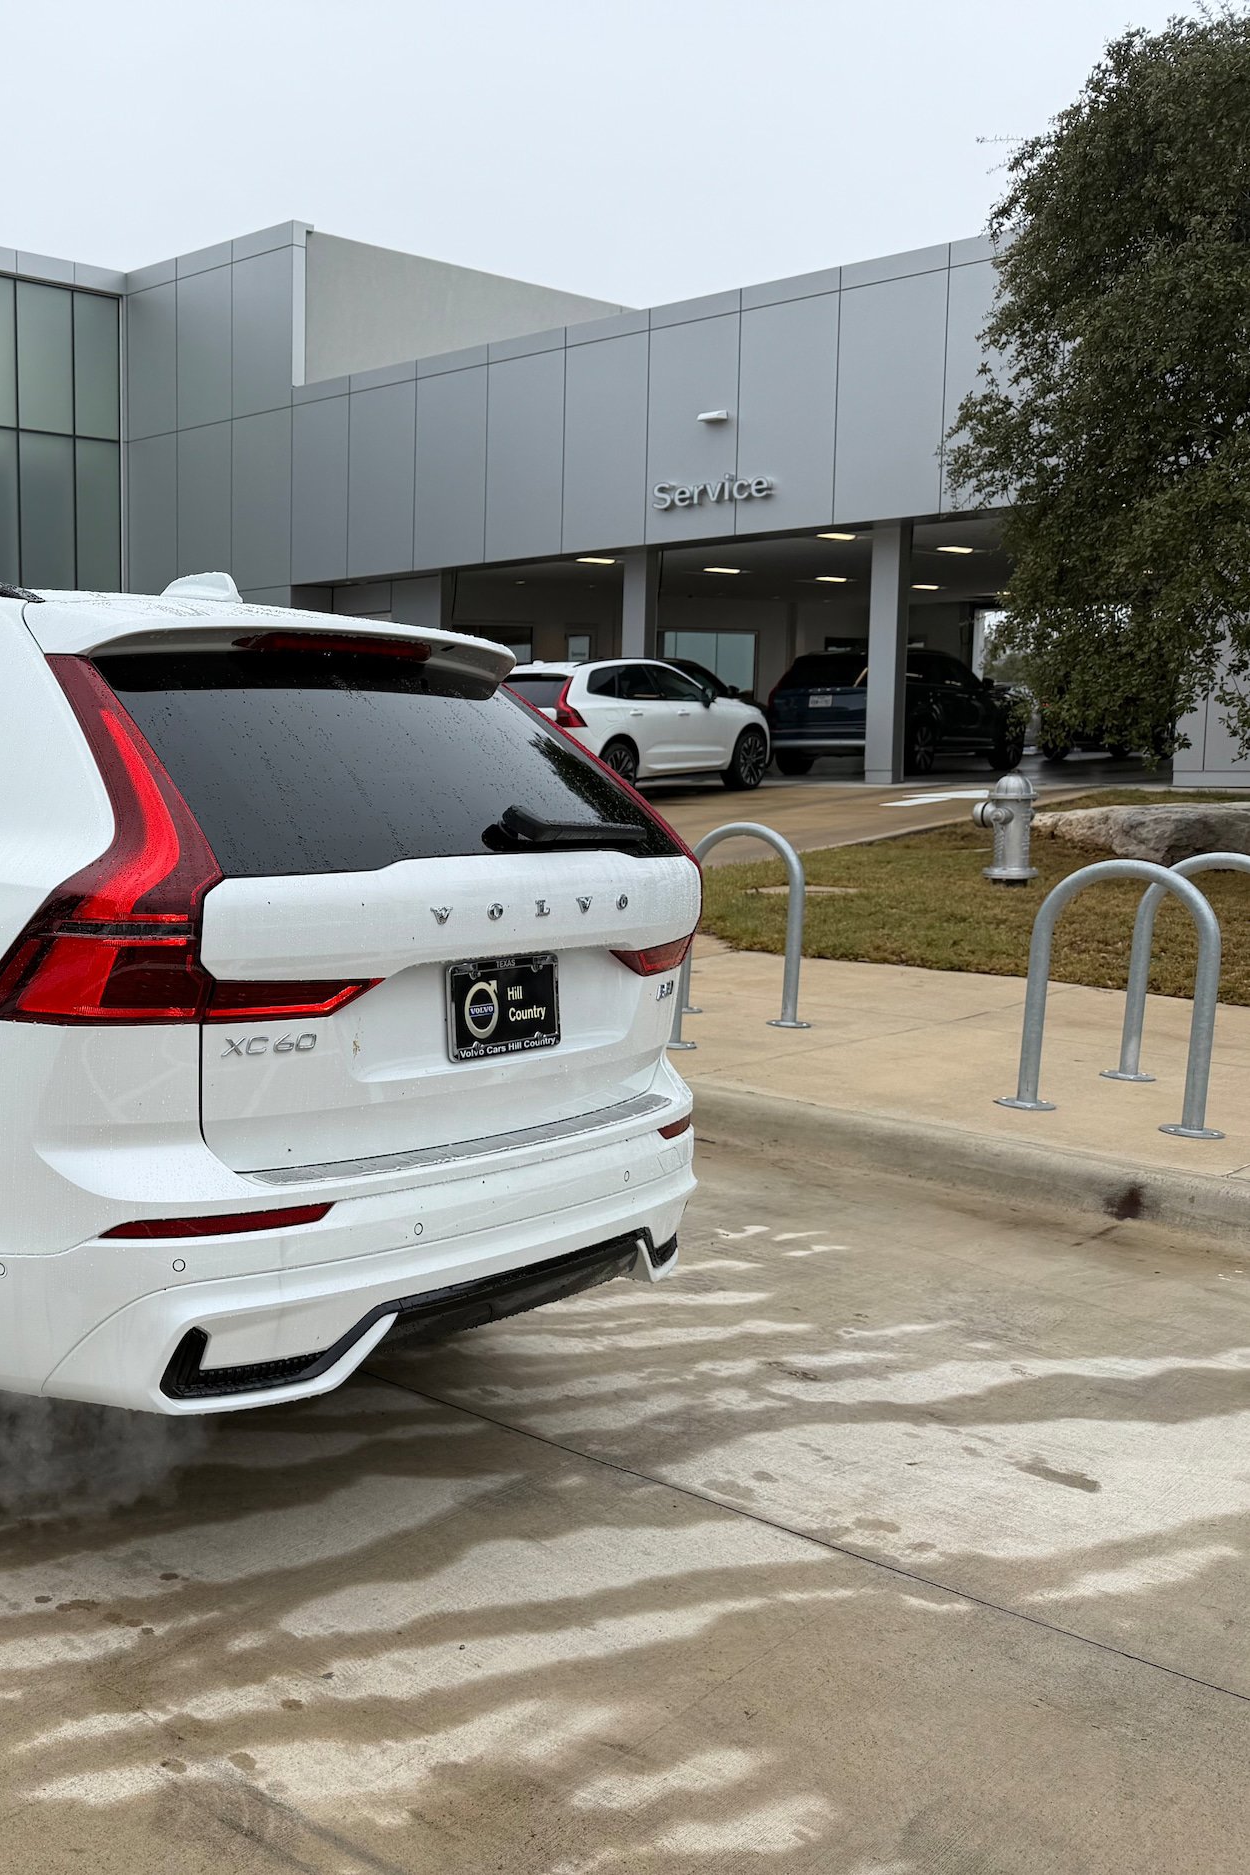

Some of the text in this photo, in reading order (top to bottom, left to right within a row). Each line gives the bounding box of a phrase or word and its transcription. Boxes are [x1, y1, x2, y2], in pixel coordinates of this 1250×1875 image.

[653, 473, 769, 509] Service
[430, 893, 629, 925] VOLVO
[496, 960, 516, 969] TEXAS
[507, 986, 523, 1001] Hill
[470, 1005, 494, 1015] VOLVO
[508, 1005, 547, 1022] Country
[221, 1032, 317, 1058] XC60
[460, 1036, 557, 1059] Volvo Cars Hill Country
